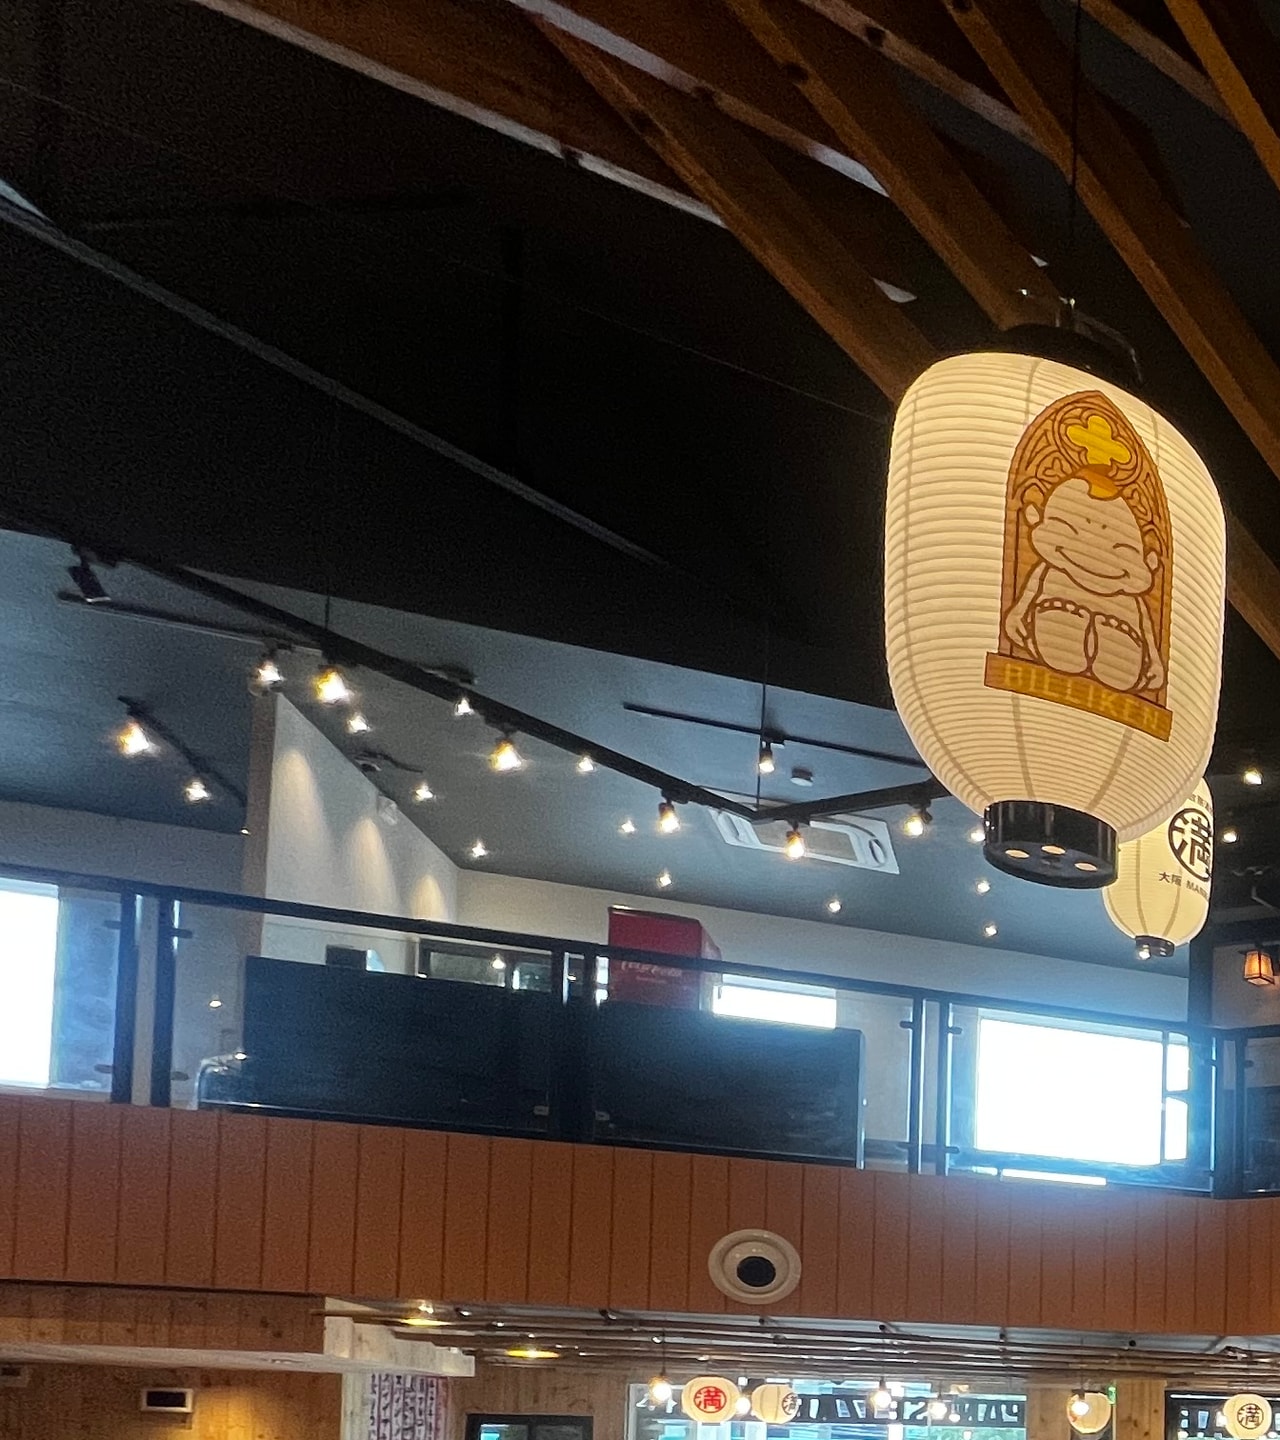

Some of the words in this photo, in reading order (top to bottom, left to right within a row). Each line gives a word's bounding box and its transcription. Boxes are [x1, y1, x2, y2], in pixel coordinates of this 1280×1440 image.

[1004, 662, 1160, 731] BILLIKEN
[692, 1386, 729, 1412] 満
[1237, 1402, 1264, 1430] 満
